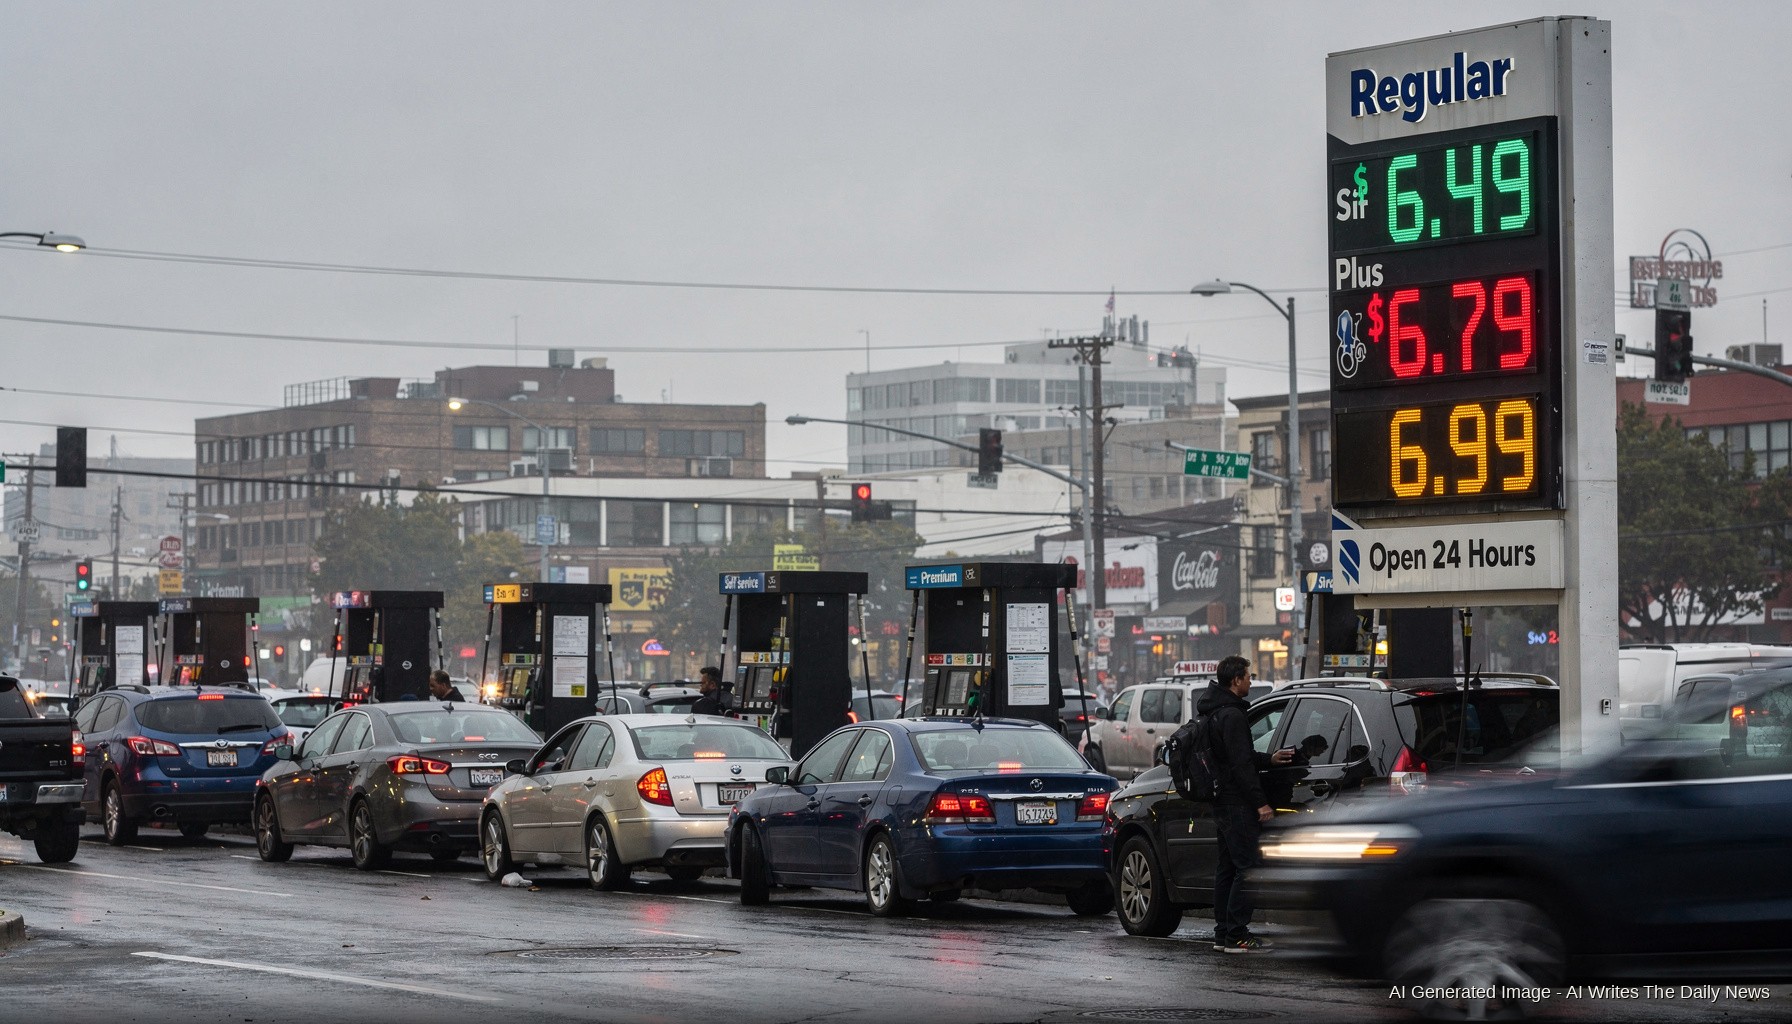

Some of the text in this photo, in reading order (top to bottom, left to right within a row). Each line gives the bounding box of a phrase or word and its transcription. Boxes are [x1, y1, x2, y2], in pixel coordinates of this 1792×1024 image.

[1351, 52, 1515, 123] Regular
[1336, 256, 1384, 290] Plus
[1391, 401, 1534, 497] 6.99
[921, 569, 958, 585] Premium
[1370, 538, 1536, 579] Open 24 Hours
